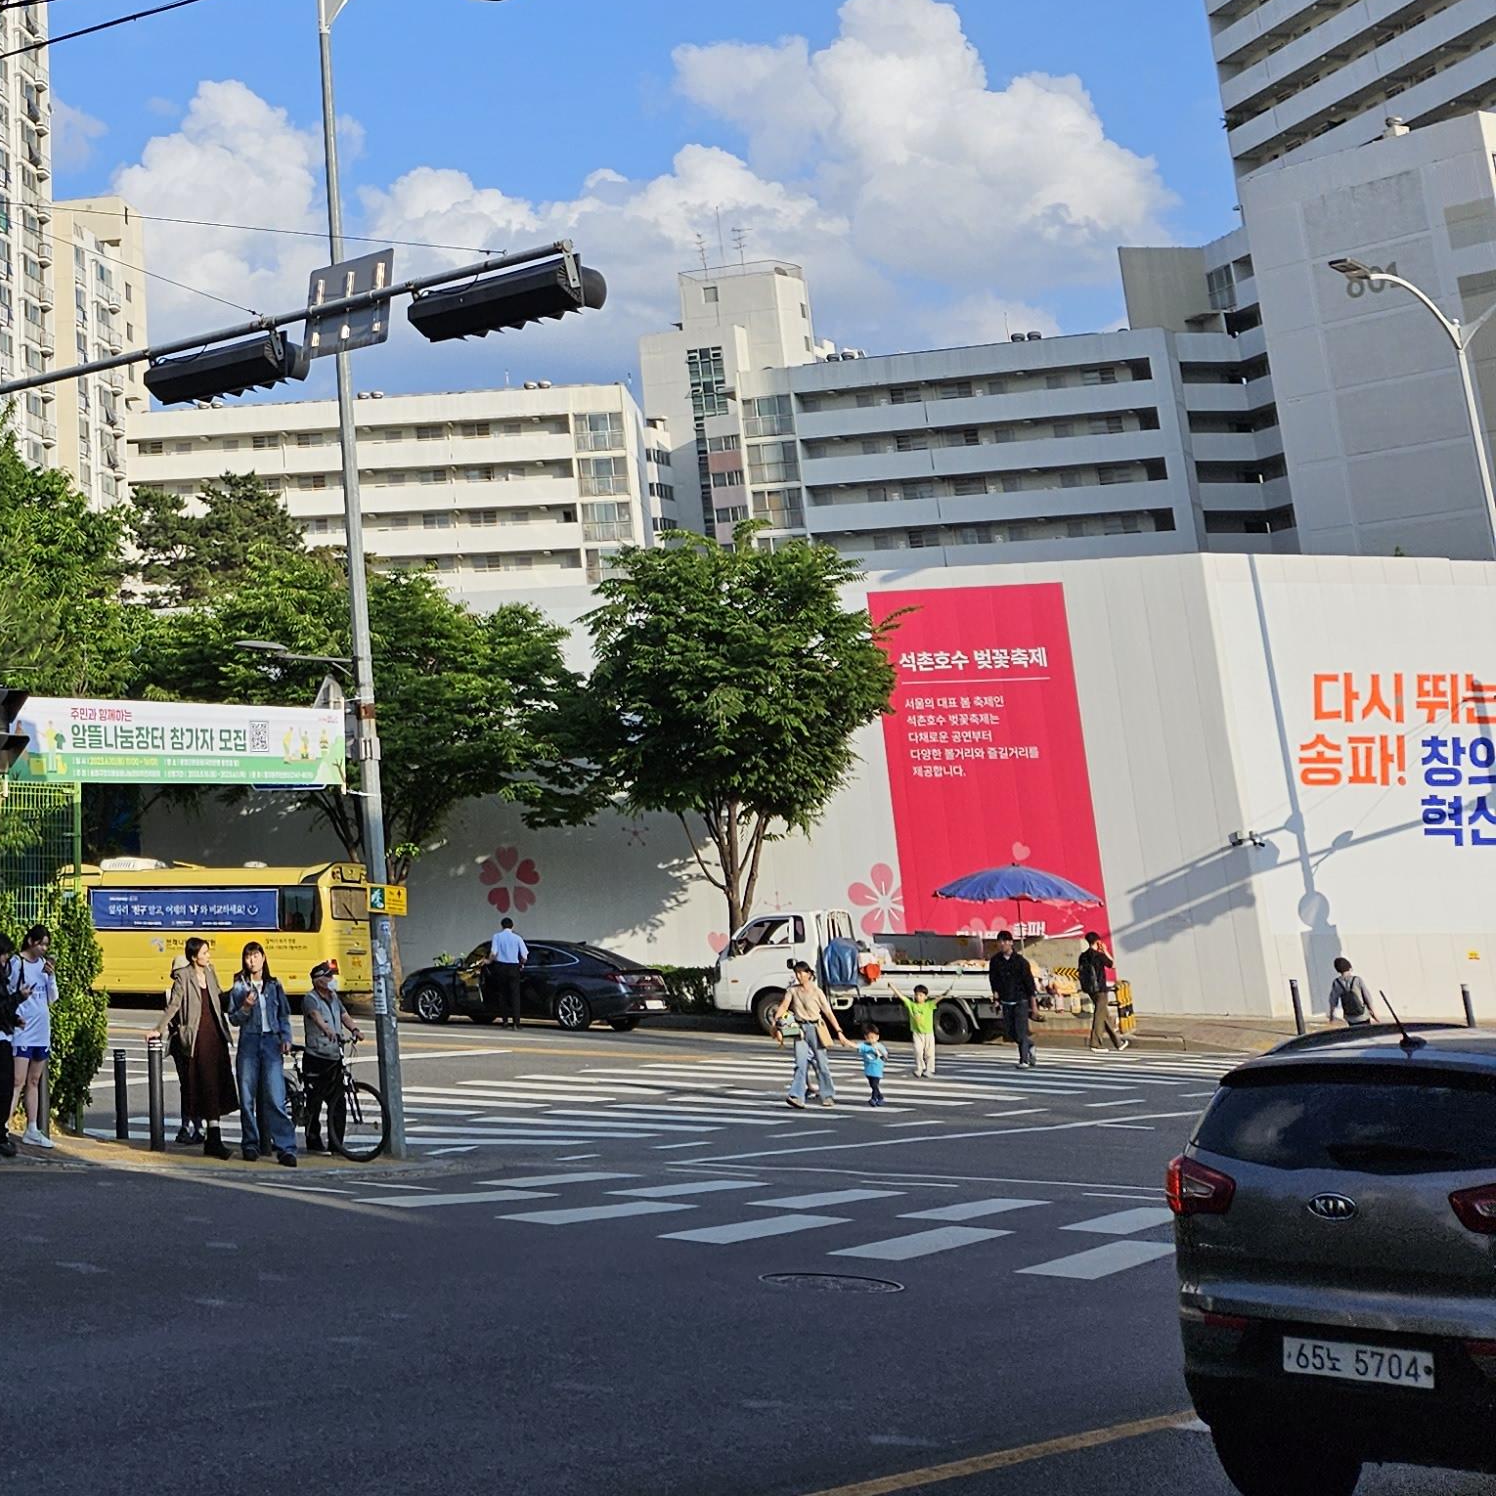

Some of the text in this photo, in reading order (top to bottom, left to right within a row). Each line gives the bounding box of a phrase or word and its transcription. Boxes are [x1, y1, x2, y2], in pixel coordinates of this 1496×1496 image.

[899, 647, 1048, 672] 석촌호수 벚꽃축제
[905, 695, 1004, 710] 서울의 대표 봄 축제인
[1313, 672, 1496, 724] 다시 뛰는
[70, 707, 132, 722] 주민과 함께하는
[907, 713, 1000, 727] 석촌호수 벚꽃축제는
[71, 724, 247, 752] 알뜰나눔장터 참가자 모집
[908, 730, 992, 744] 다채로운 공연부터
[910, 746, 1040, 761] 다양한 볼거리와 즐길거리를
[1299, 734, 1407, 786] 송파!
[912, 765, 967, 778] 제공합니다.
[1315, 1198, 1347, 1213] KIA
[1296, 1344, 1421, 1383] 65노 5704
